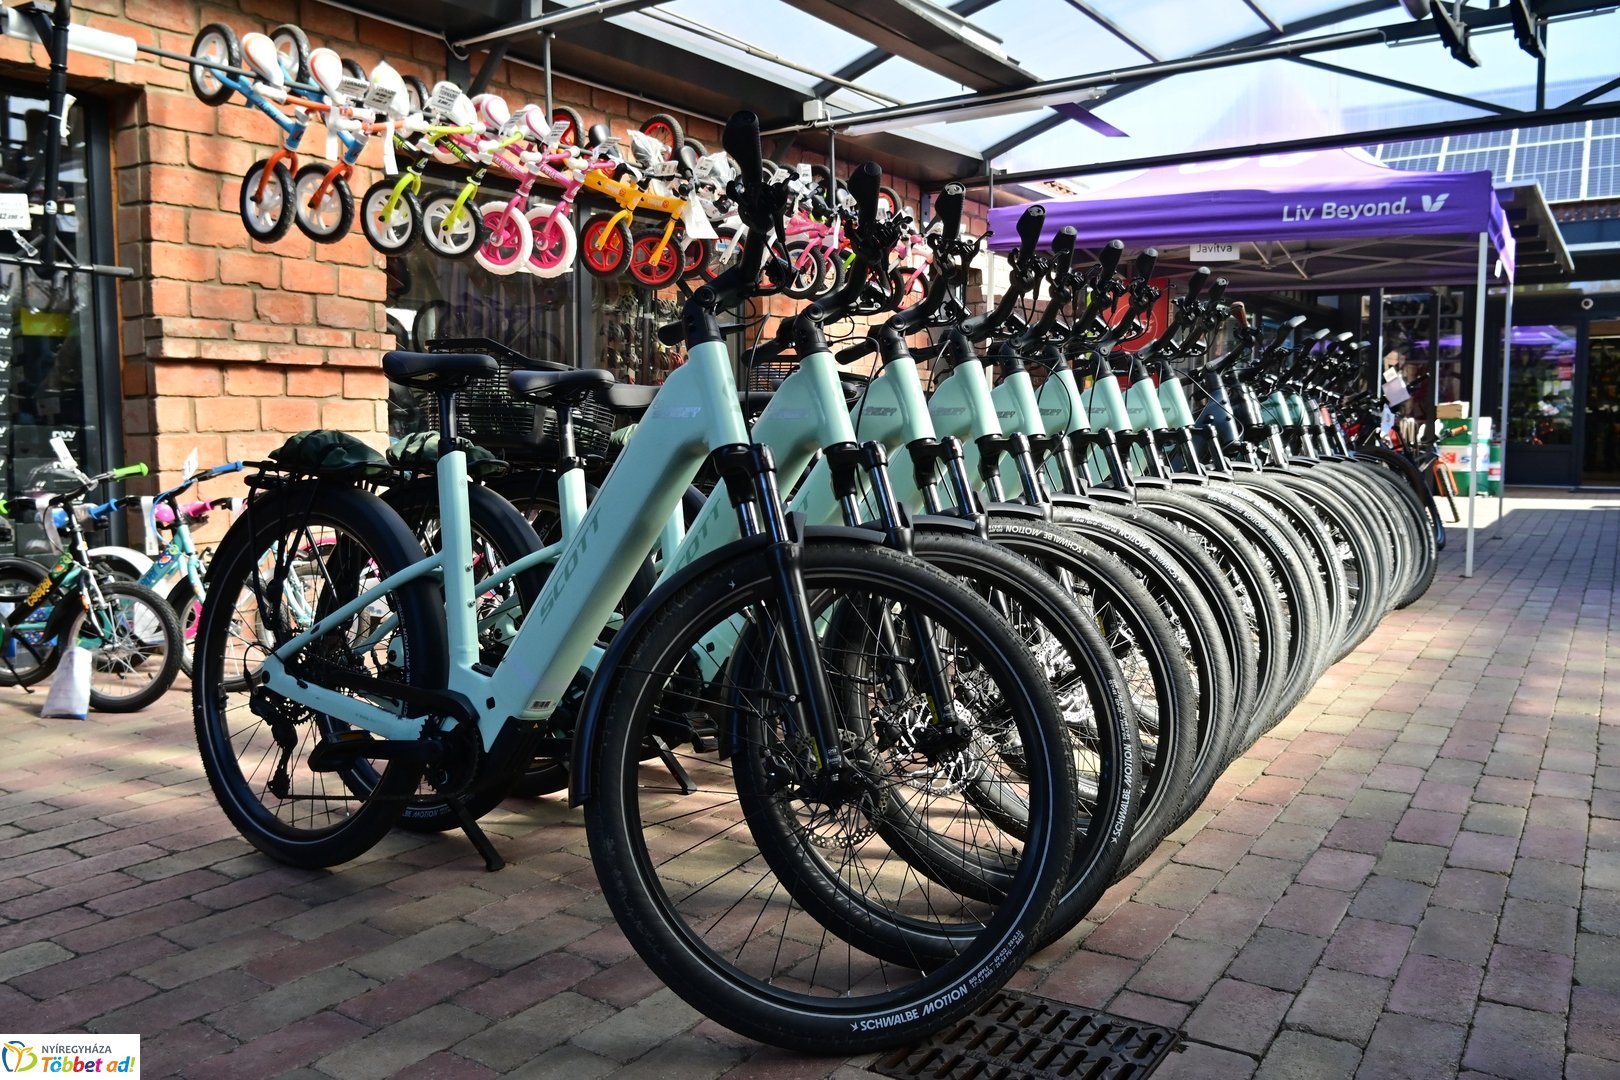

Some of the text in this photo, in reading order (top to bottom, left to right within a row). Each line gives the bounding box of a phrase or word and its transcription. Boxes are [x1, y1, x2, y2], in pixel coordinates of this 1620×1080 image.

[1282, 196, 1411, 222] Liv Beyond.
[1005, 524, 1083, 553] SCHWALBE MOTION
[1118, 529, 1178, 578] SCHWALBE MOTION
[540, 507, 601, 624] SCOTT
[1115, 743, 1133, 838] SCHWALBE MOTION
[860, 983, 968, 1031] SCHWALBE MOTION
